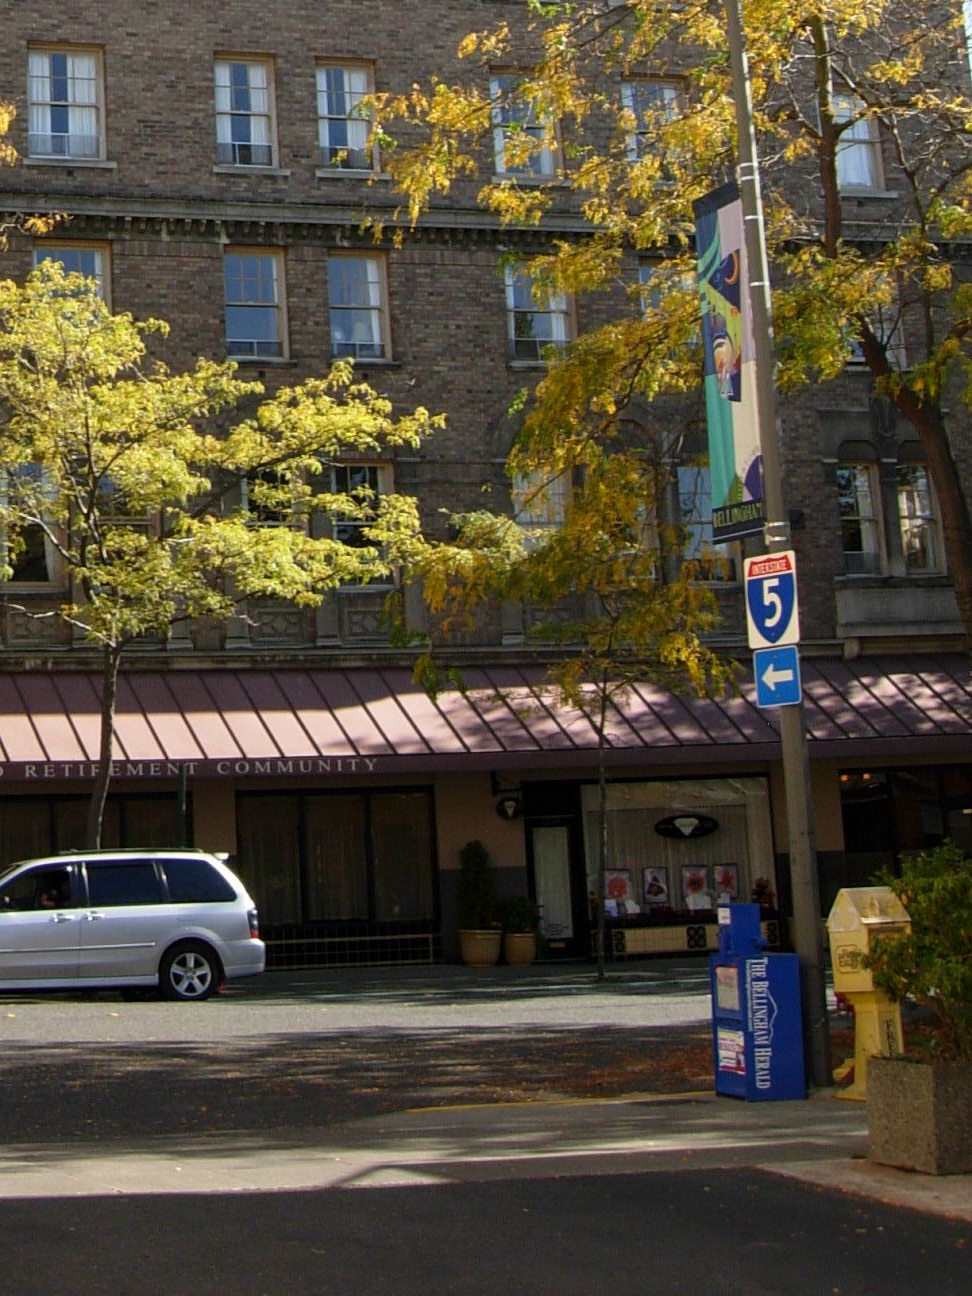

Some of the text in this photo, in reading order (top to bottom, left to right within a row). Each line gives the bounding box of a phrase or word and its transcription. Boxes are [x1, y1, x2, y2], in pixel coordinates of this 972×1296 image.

[713, 502, 763, 528] BELLINGHAM
[751, 559, 788, 575] INTERSTATE
[763, 578, 782, 627] 5
[216, 758, 378, 775] COMMUNITY
[751, 957, 772, 1089] THE BELLINGHAM HERALD
